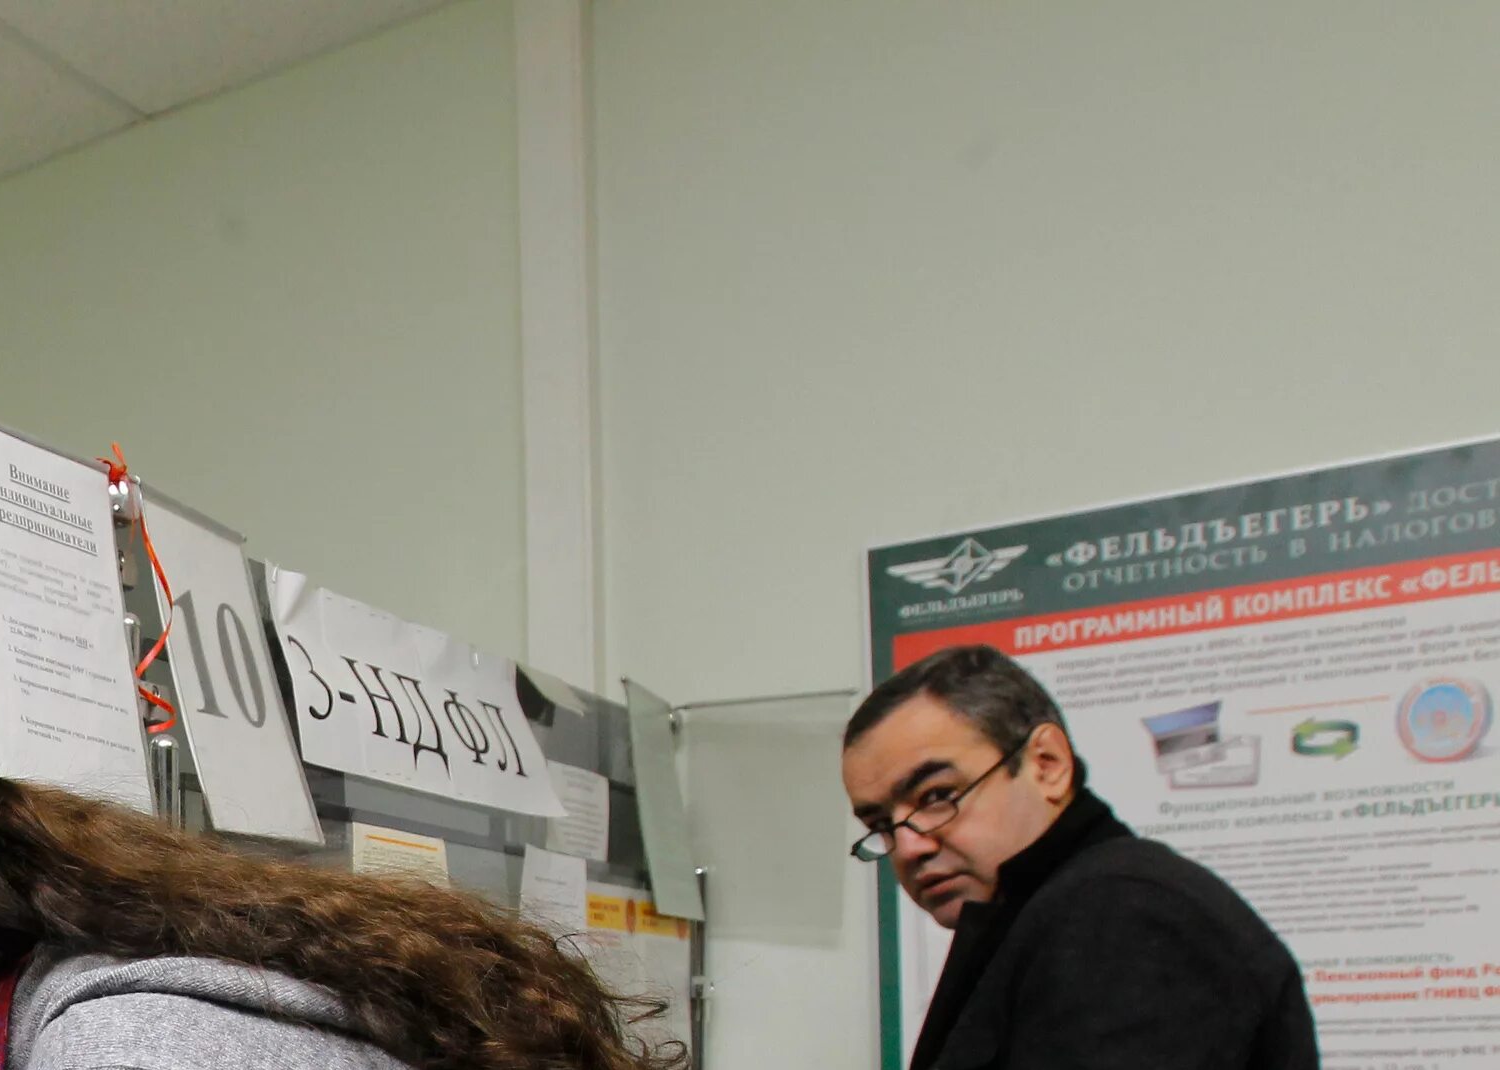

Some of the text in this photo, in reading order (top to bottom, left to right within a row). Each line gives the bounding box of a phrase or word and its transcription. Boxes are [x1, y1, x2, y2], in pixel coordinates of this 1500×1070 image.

[8, 463, 70, 500] Внимание
[1046, 496, 1393, 567] «ФЕЛЬДЪЕГЕРЬ»
[1062, 508, 1498, 592] ОТЧЕТНОСТЬ В НАЛОГОВ
[1014, 595, 1224, 649] ПРОГРАММНЫЙ
[1232, 575, 1392, 618] КОМПЛЕКС
[173, 589, 266, 728] 10
[287, 634, 528, 781] 3-НДФЛ
[1158, 779, 1456, 817] Функциональные возможности
[1234, 809, 1334, 830] комплекса
[1430, 965, 1477, 981] фонд
